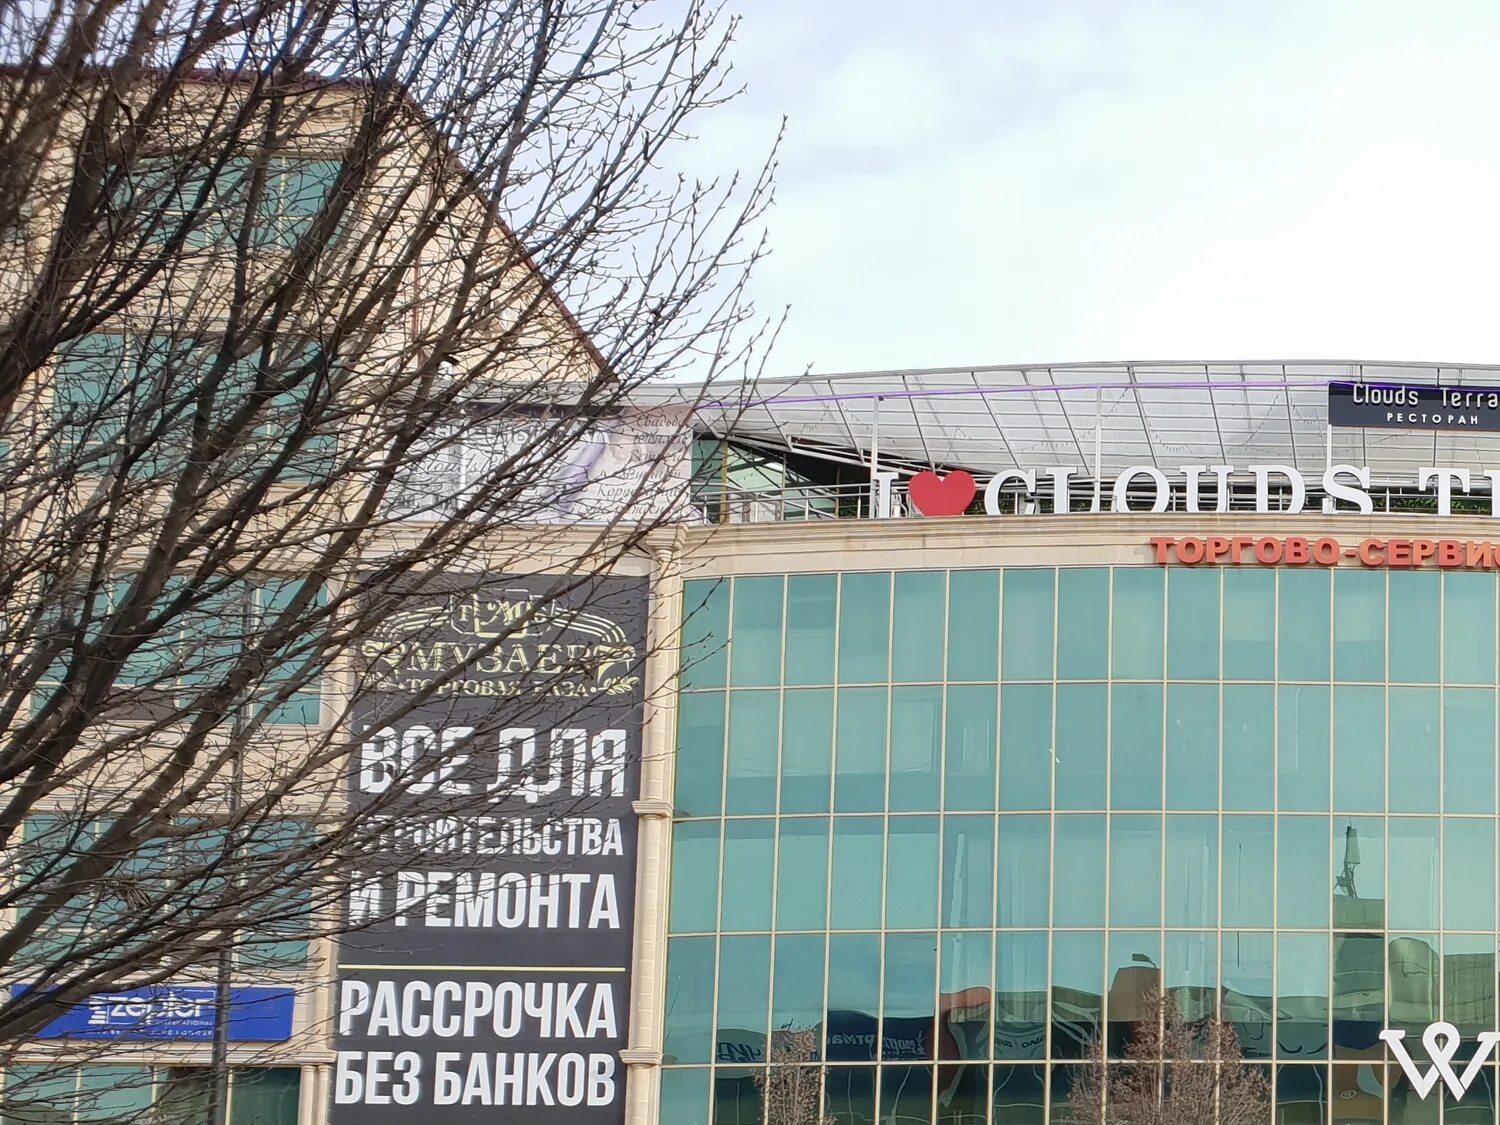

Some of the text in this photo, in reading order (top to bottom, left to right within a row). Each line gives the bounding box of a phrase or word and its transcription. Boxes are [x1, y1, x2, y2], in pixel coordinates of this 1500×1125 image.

[1353, 383, 1419, 407] Clouds
[1386, 412, 1479, 425] РЕСТОРАН
[985, 465, 1374, 515] CLOUDS
[360, 724, 628, 803] ВСЕ ДЛЯ
[395, 871, 621, 929] РЕМОНТА
[339, 980, 618, 1039] РАССРОЧКА
[335, 1051, 616, 1107] БЕЗ БАНКОВ
